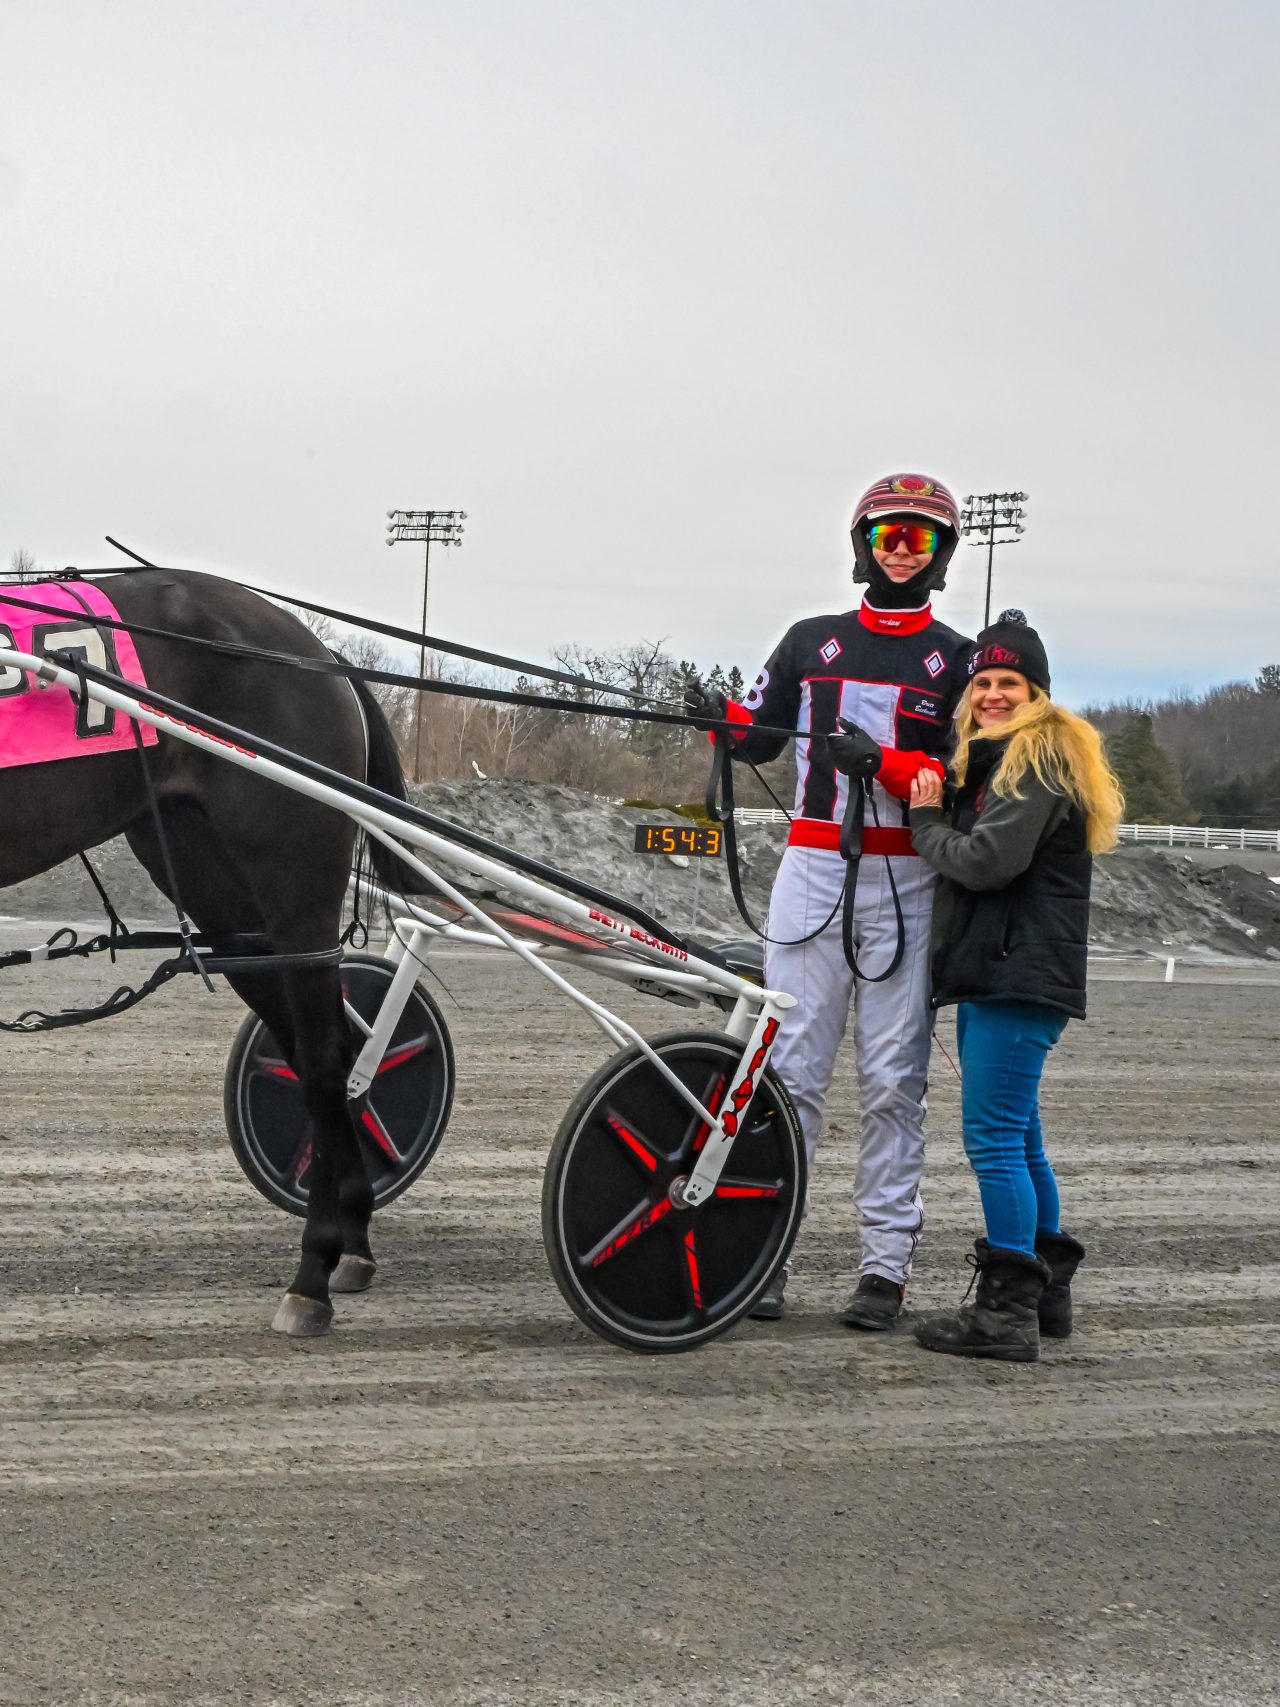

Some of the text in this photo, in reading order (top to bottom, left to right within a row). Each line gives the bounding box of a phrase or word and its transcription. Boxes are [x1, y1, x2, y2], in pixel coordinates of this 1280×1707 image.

[43, 627, 107, 729] 7
[589, 907, 689, 962] BRETT BECKWITH
